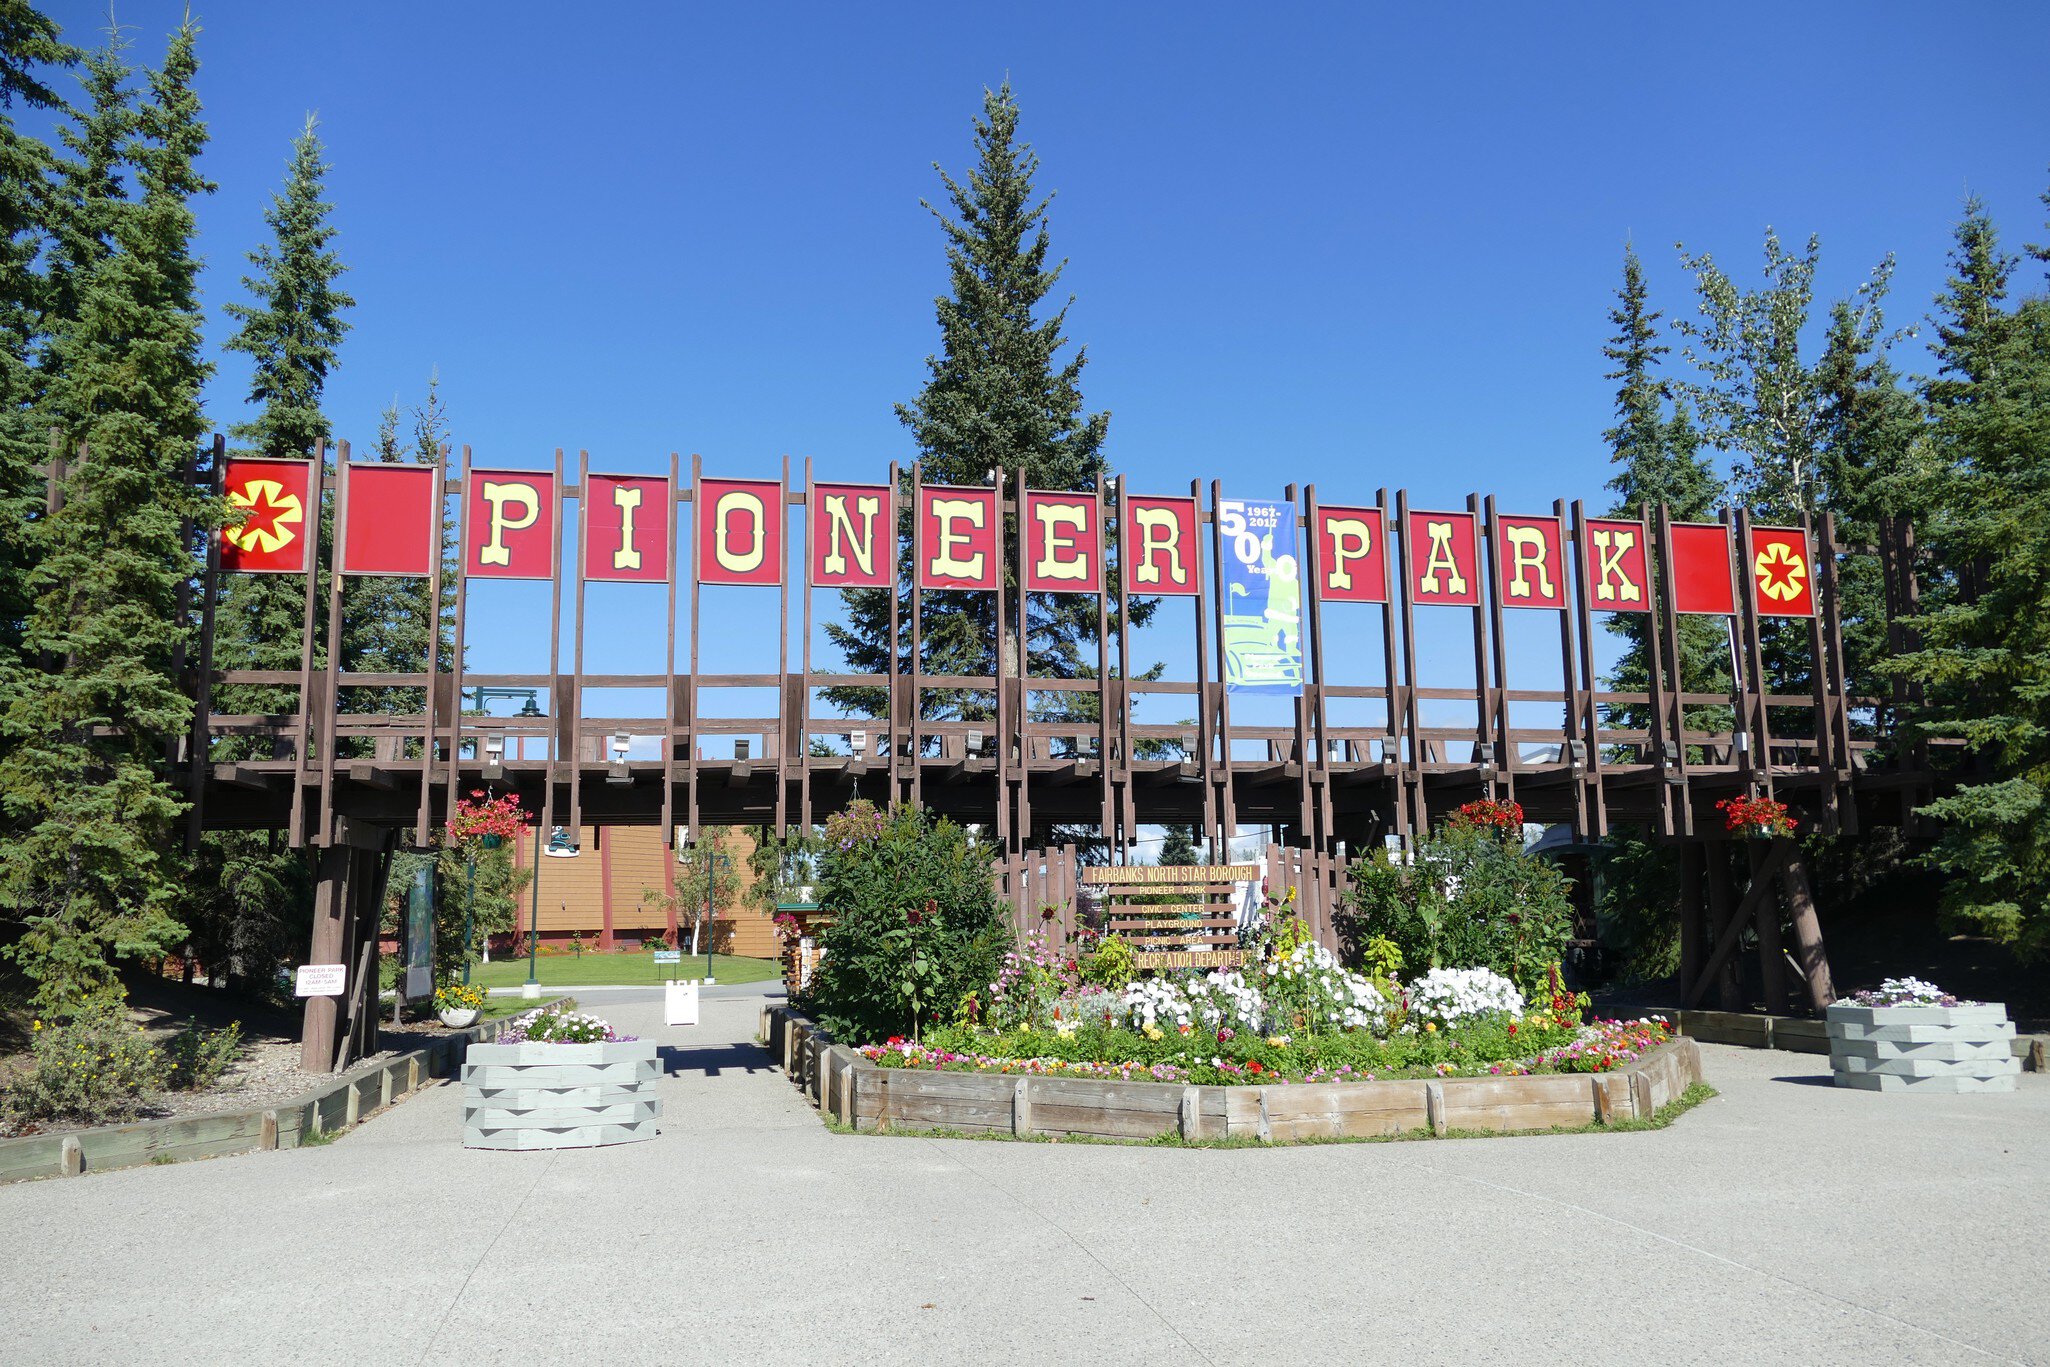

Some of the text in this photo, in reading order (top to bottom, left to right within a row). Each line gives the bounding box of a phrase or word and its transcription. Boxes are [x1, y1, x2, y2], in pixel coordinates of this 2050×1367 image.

[1249, 518, 1278, 528] 2017
[480, 481, 1640, 602] PIONEER PARK
[1092, 866, 1253, 883] FAIRBANKS NORTH STAR BOROUGH
[1139, 886, 1206, 895] PIONEER PARK
[1141, 904, 1205, 914] CIVIC CENTER
[1145, 919, 1203, 929] PLAYGROUND
[1145, 936, 1204, 946] PICNIC AREA
